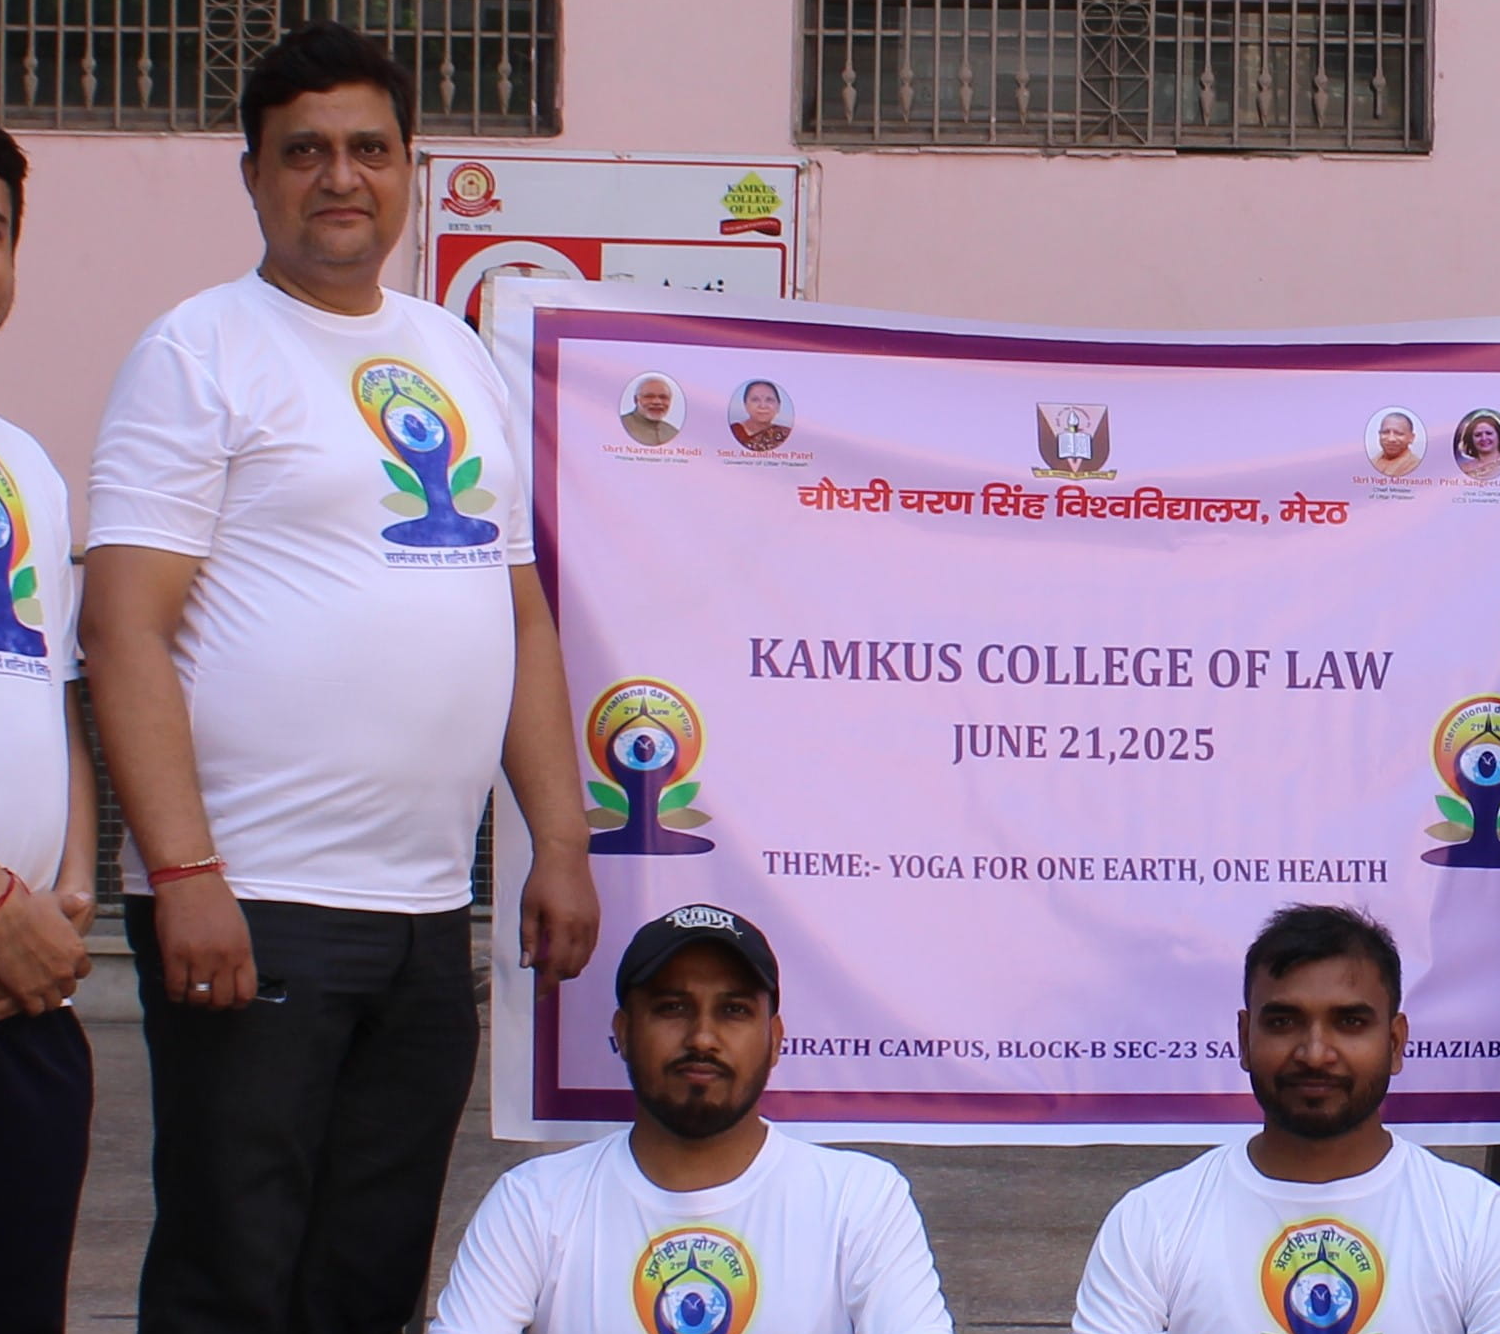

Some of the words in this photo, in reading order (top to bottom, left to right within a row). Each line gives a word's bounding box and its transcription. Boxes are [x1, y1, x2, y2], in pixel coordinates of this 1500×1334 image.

[724, 194, 779, 204] COLLEGE
[727, 184, 776, 194] KAMKUS
[730, 205, 744, 213] OF
[747, 205, 772, 214] LAW
[676, 447, 702, 456] Modi
[791, 451, 813, 460] Patel
[798, 477, 893, 512] चौधरी
[898, 489, 975, 515] चरण
[981, 482, 1048, 519] सिंह
[1055, 485, 1270, 525] विश्वविद्यालय,
[1279, 490, 1350, 525] मेरठ
[748, 637, 963, 684] KAMKUS
[977, 644, 1194, 688] COLLEGE
[1207, 648, 1271, 690] OF
[1285, 649, 1394, 691] LAW
[596, 686, 647, 737] International
[649, 688, 670, 703] day
[671, 700, 683, 711] of
[1444, 703, 1492, 752] International
[952, 723, 1047, 765] JUNE
[1059, 726, 1216, 765] 21,2025
[762, 850, 881, 879] THEME:-
[889, 853, 964, 880] YOGA
[972, 855, 1030, 881] FOR
[1036, 855, 1095, 882] ONE
[1102, 857, 1206, 886] EARTH,
[1212, 858, 1270, 884] ONE
[1278, 859, 1388, 885] HEALTH
[776, 1038, 871, 1058] GIRATH
[878, 1038, 990, 1061] CAMPUS,
[997, 1039, 1106, 1060] BLOCK-B
[1112, 1040, 1198, 1060] SEC-23
[1204, 1040, 1241, 1060] SA
[693, 1235, 718, 1252] योग
[718, 1245, 744, 1278] दिवस
[1321, 1227, 1346, 1244] योग
[1346, 1240, 1371, 1272] दिवस
